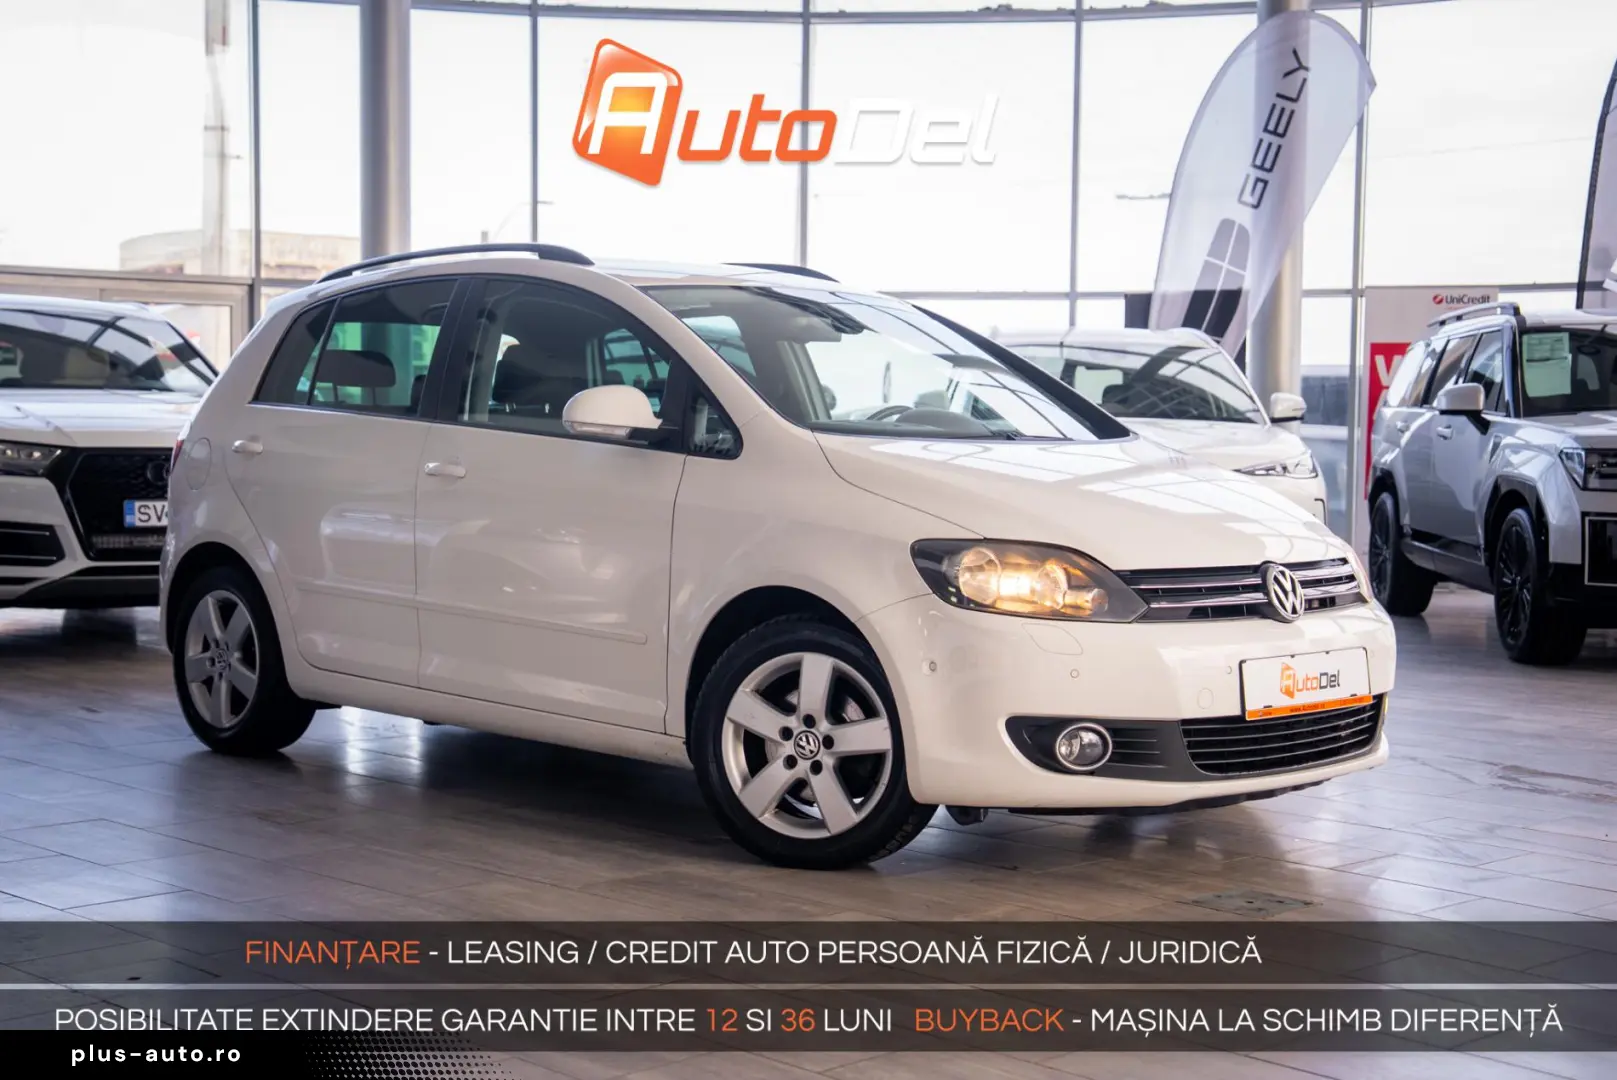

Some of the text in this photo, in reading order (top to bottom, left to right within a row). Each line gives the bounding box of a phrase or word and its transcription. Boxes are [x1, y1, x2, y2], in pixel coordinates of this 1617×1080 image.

[1238, 47, 1311, 209] GEELY
[1445, 294, 1490, 304] UniCredit
[1280, 667, 1340, 695] AutoDel
